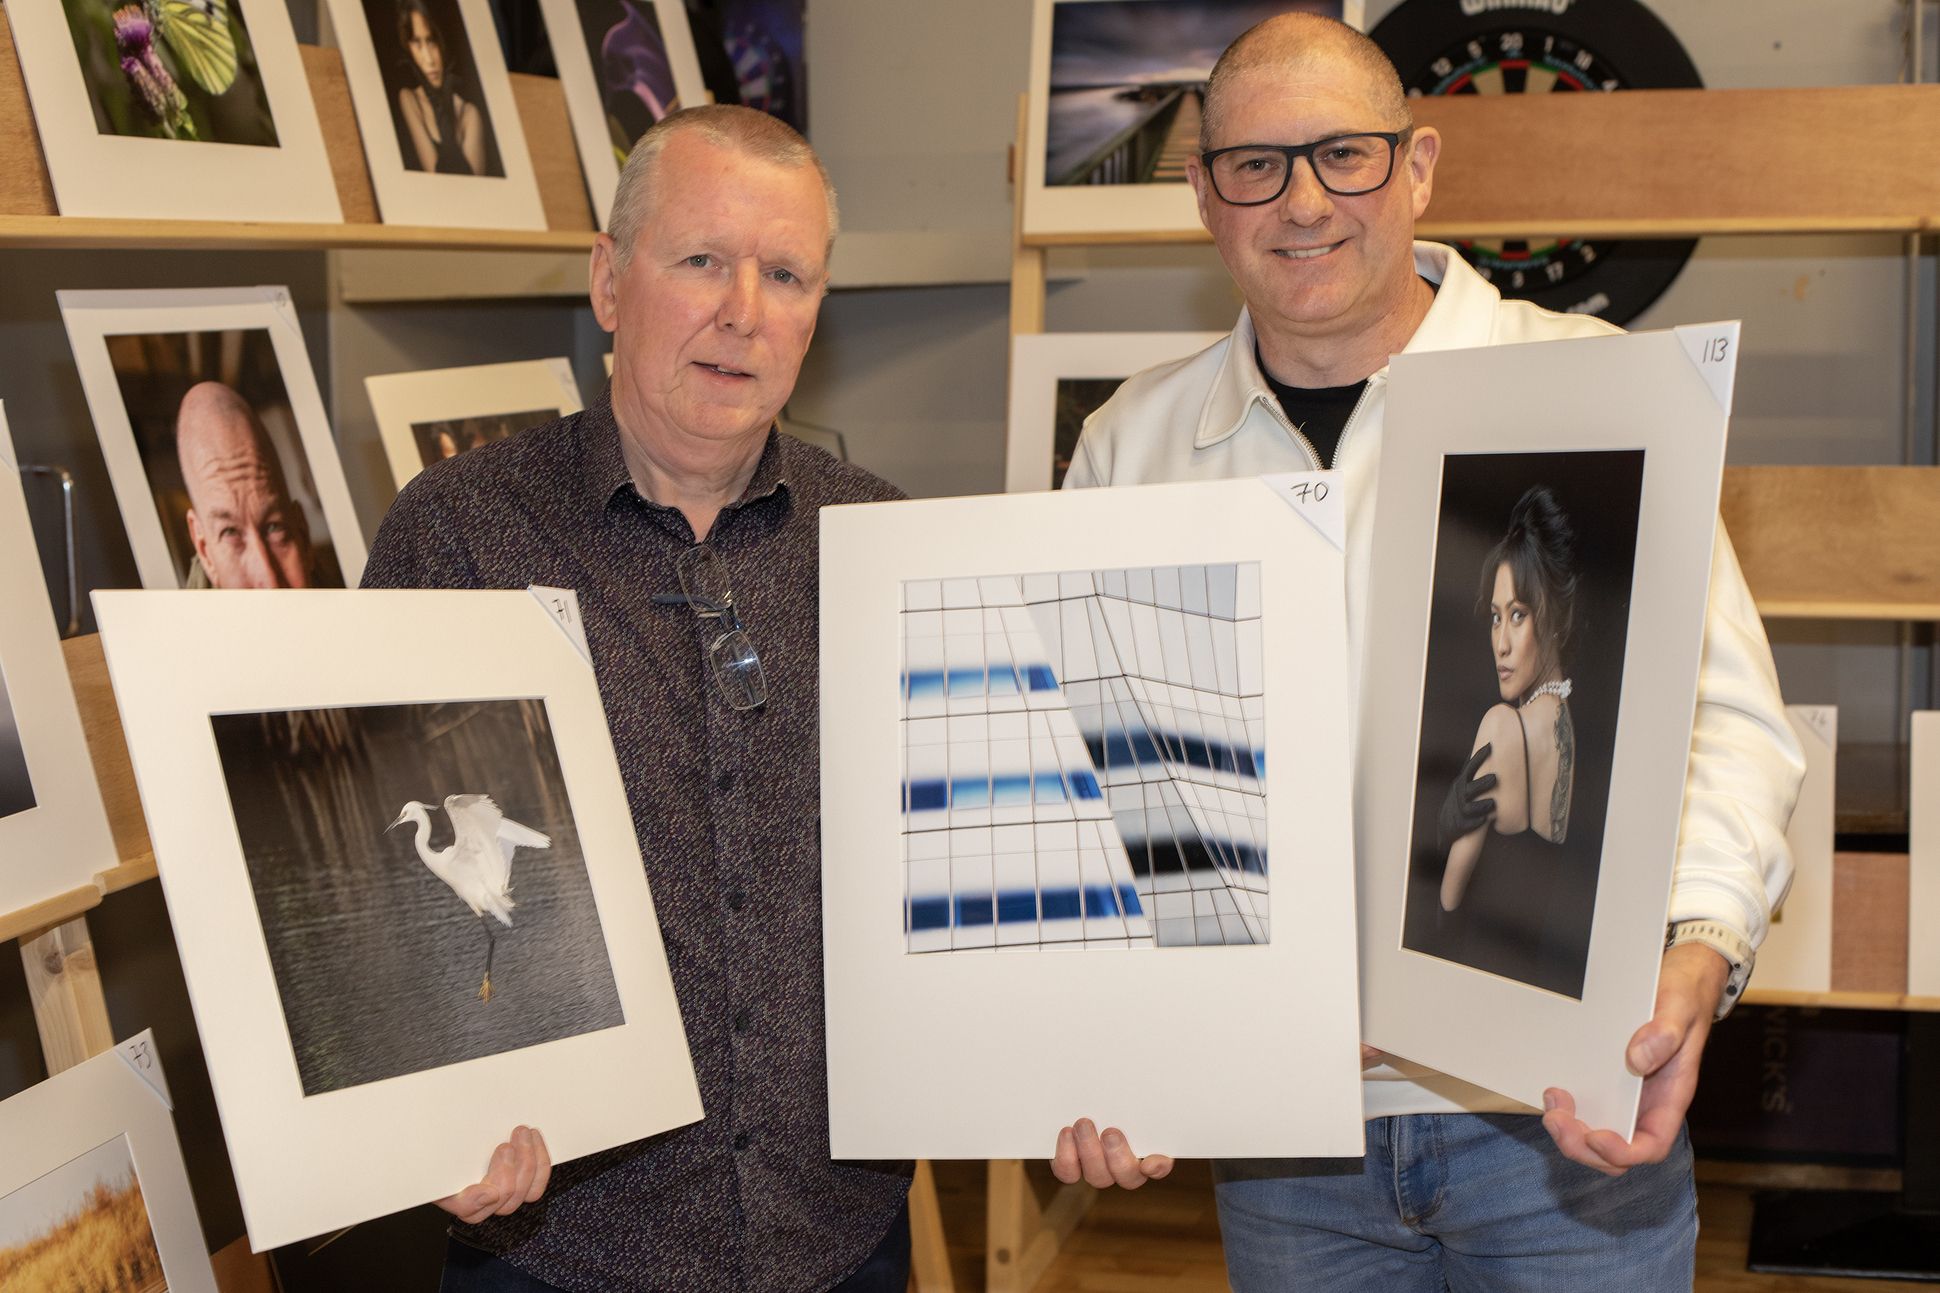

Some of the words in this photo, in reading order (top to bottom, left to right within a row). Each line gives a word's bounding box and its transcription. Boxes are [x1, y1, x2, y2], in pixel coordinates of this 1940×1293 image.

[1500, 31, 1523, 51] 20
[1702, 337, 1729, 364] 113
[1289, 481, 1330, 505] 70
[551, 598, 573, 624] 71
[129, 1041, 152, 1070] 73
